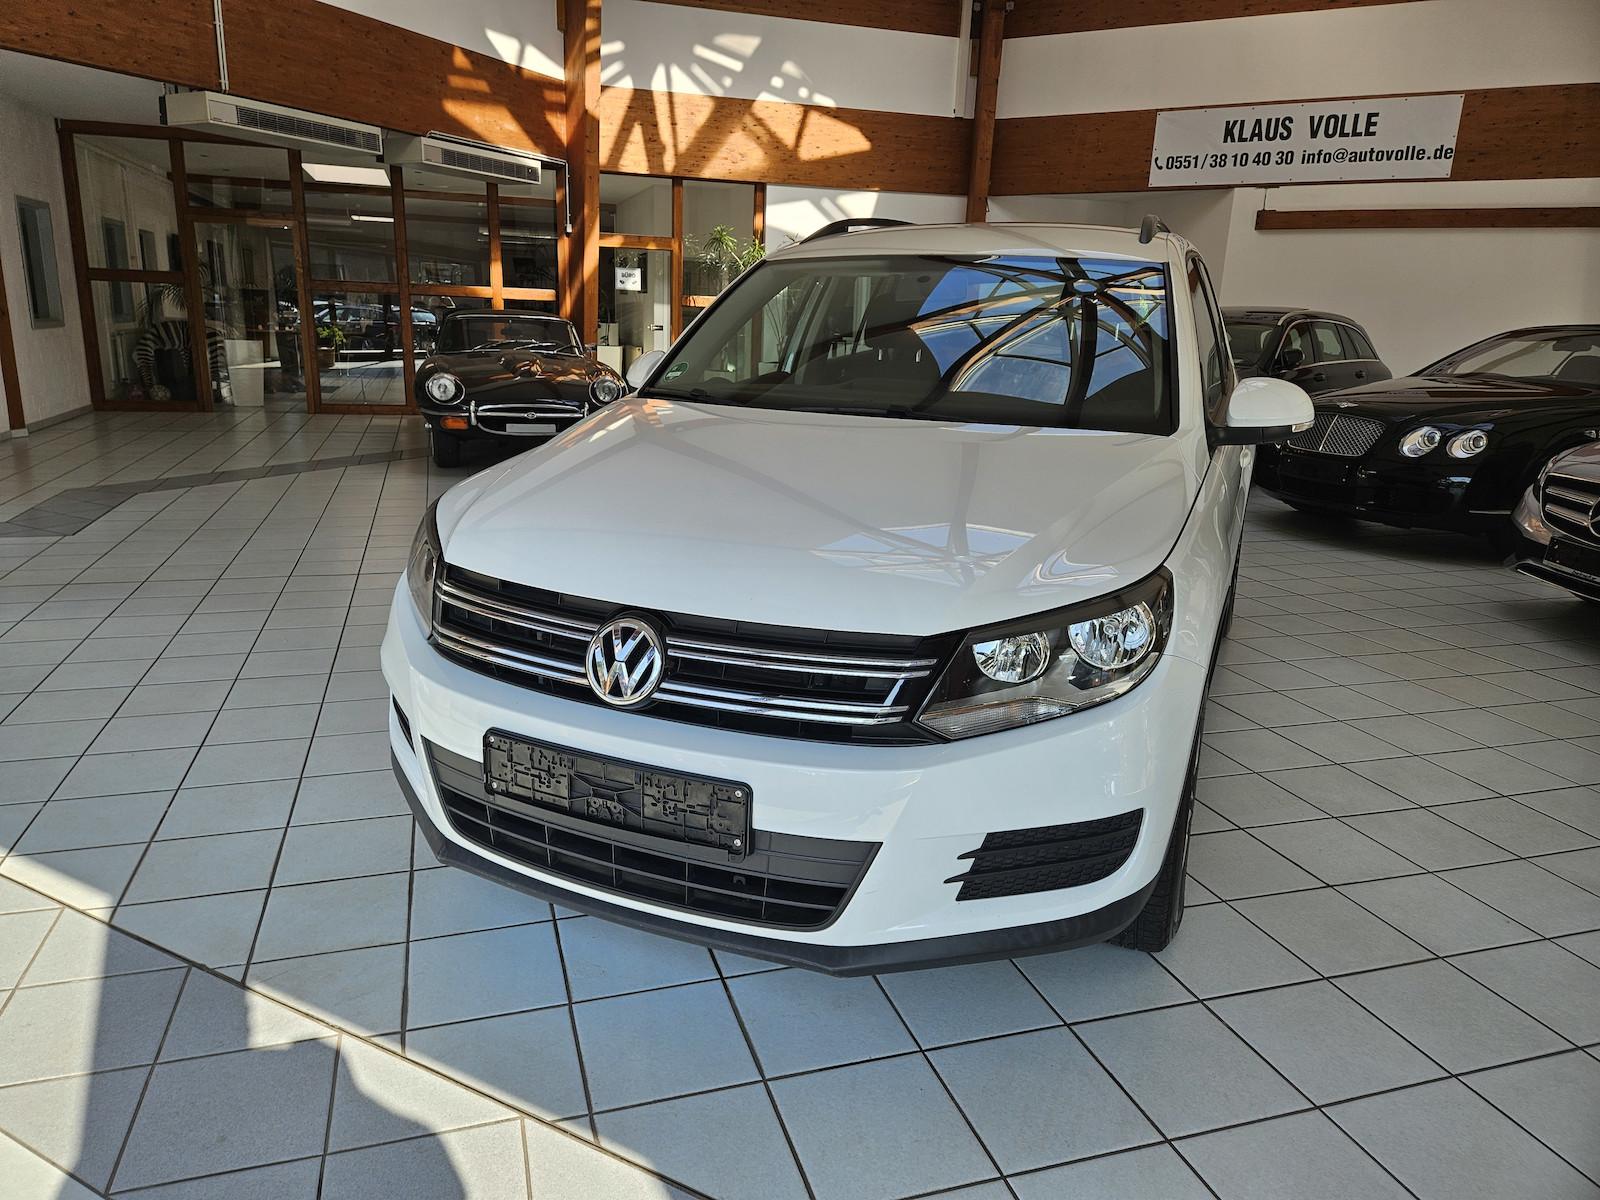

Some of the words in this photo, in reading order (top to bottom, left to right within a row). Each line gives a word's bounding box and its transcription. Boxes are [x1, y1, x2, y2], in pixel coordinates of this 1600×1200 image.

[1222, 115, 1294, 143] KLAUS
[1309, 112, 1380, 139] VOLLE
[1231, 152, 1249, 167] 10
[1252, 151, 1271, 166] 40
[1275, 150, 1294, 165] 30
[1301, 144, 1454, 165] info@autovolle.de
[592, 621, 658, 701] VW
